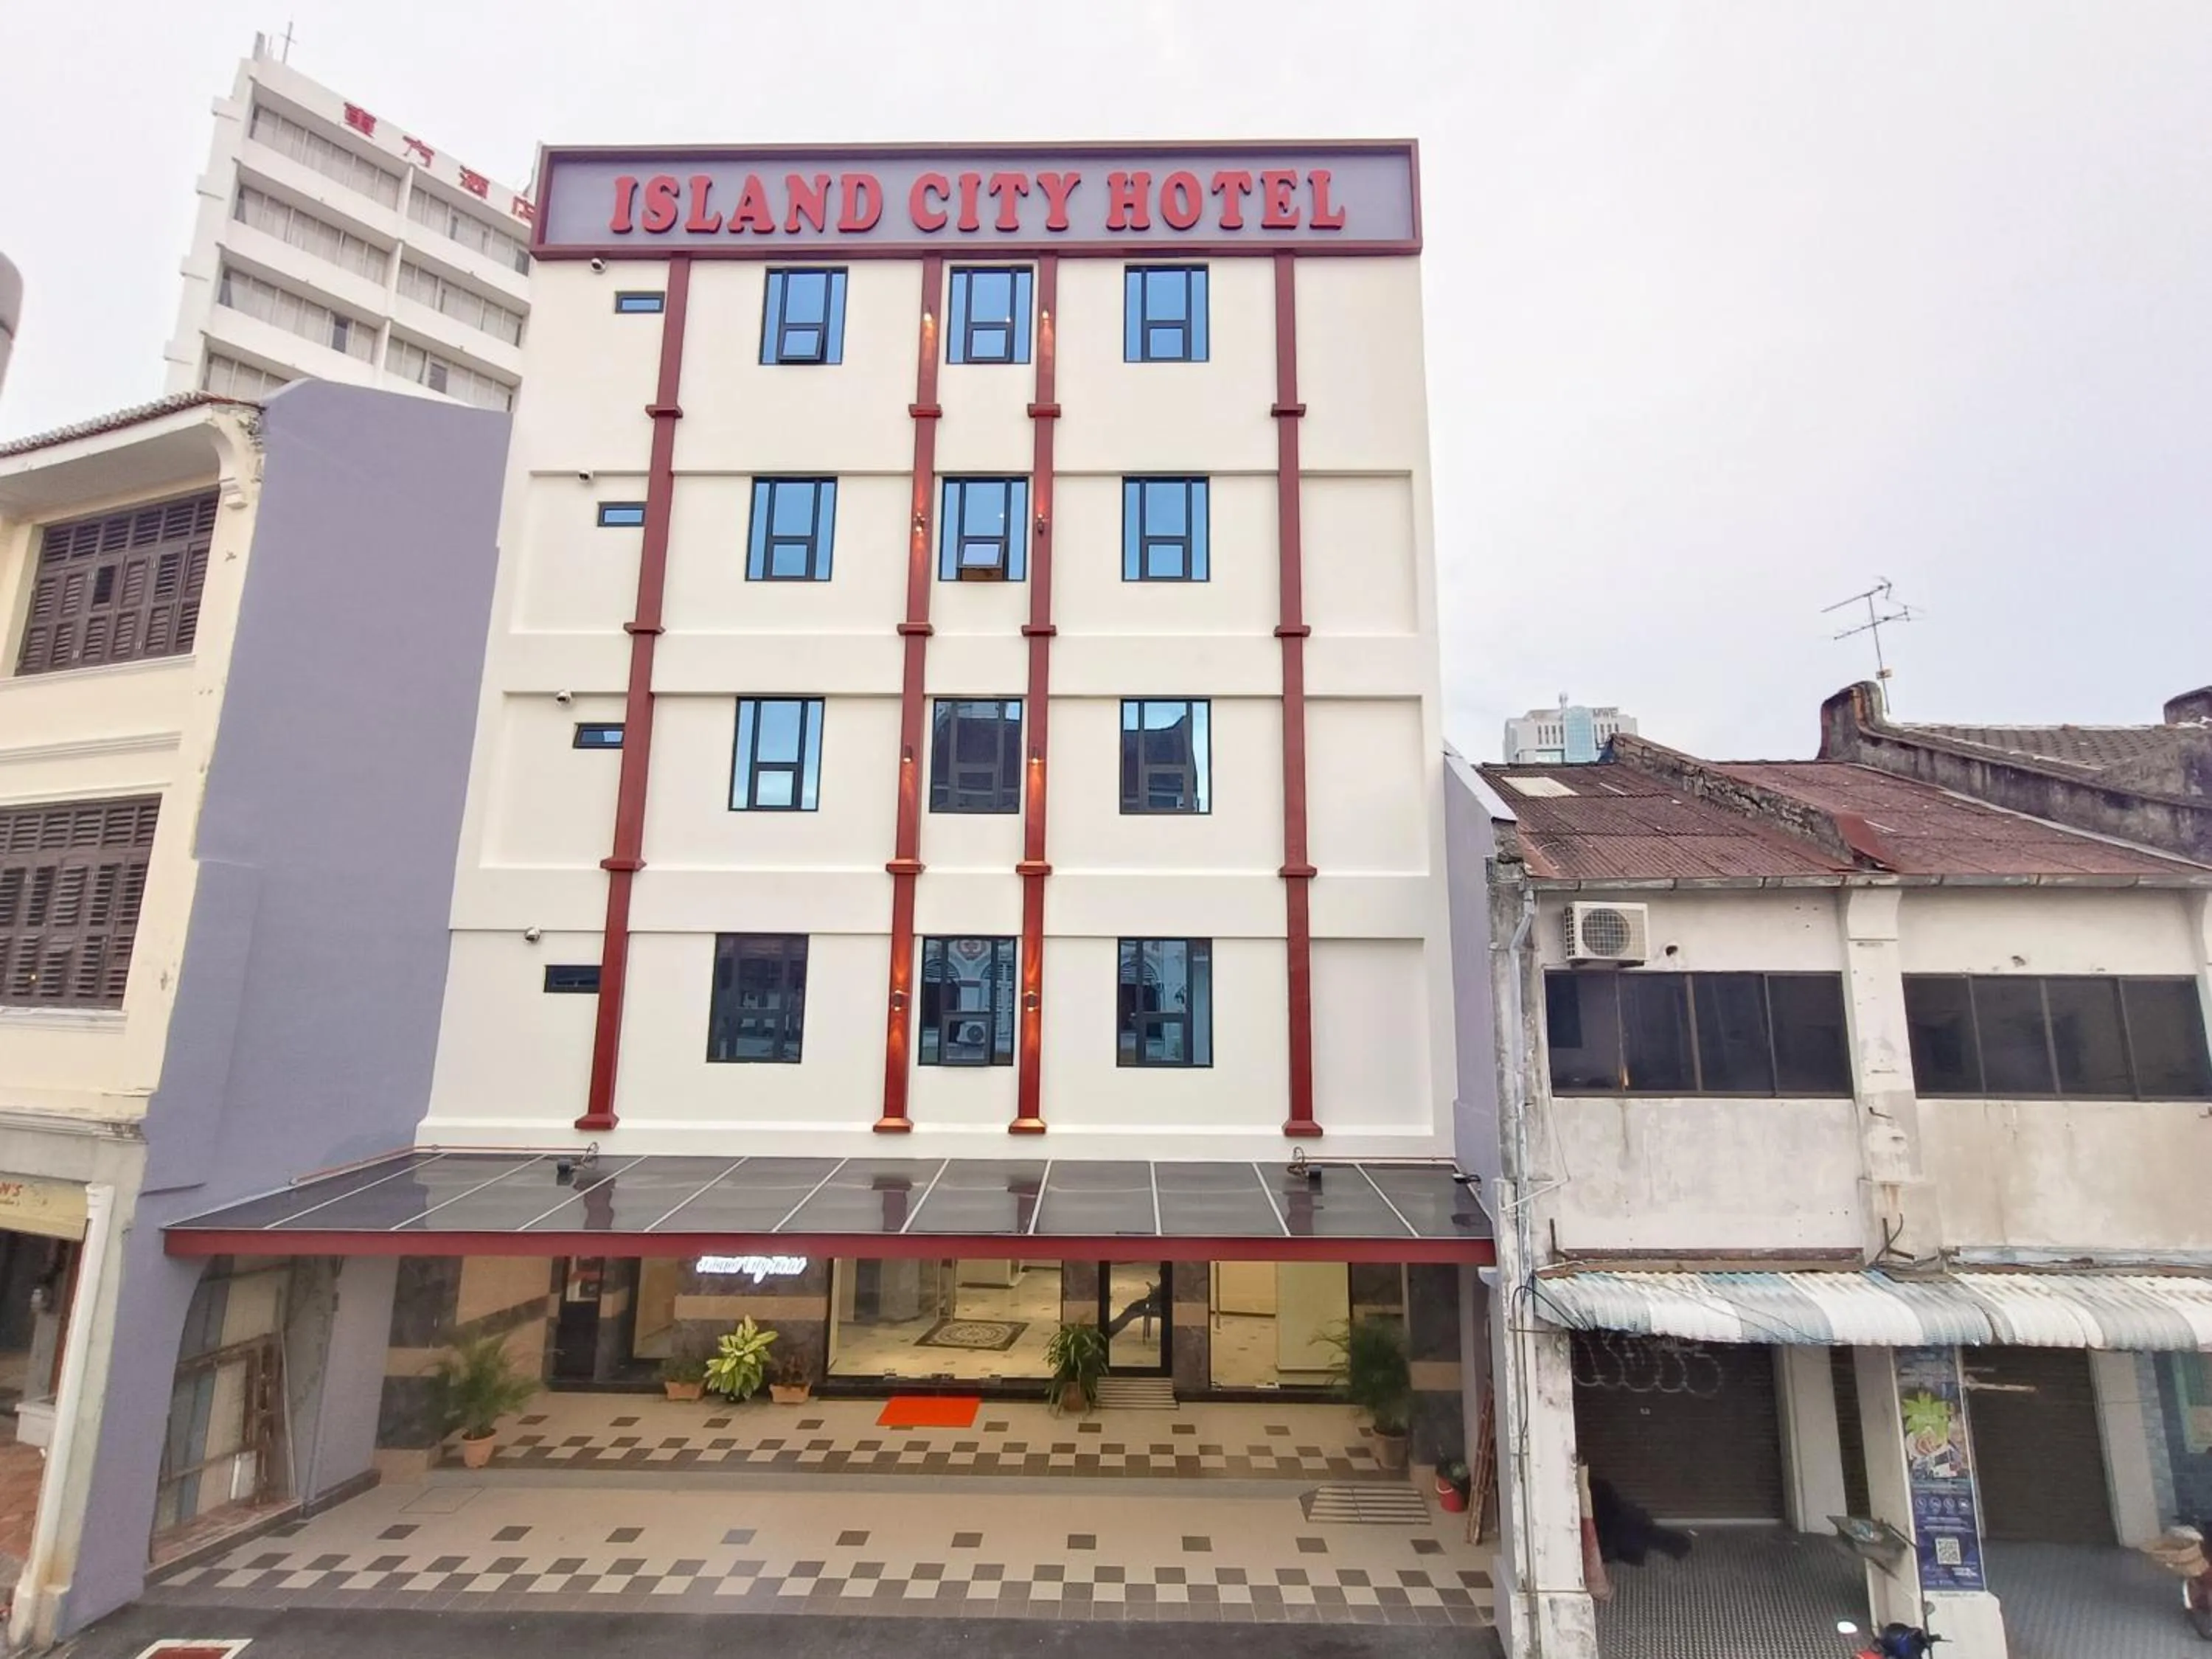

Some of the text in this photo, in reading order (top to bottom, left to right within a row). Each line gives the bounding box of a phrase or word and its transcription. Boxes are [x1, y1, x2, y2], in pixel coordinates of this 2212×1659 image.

[610, 170, 1346, 234] ISLAND CITY HOTEL
